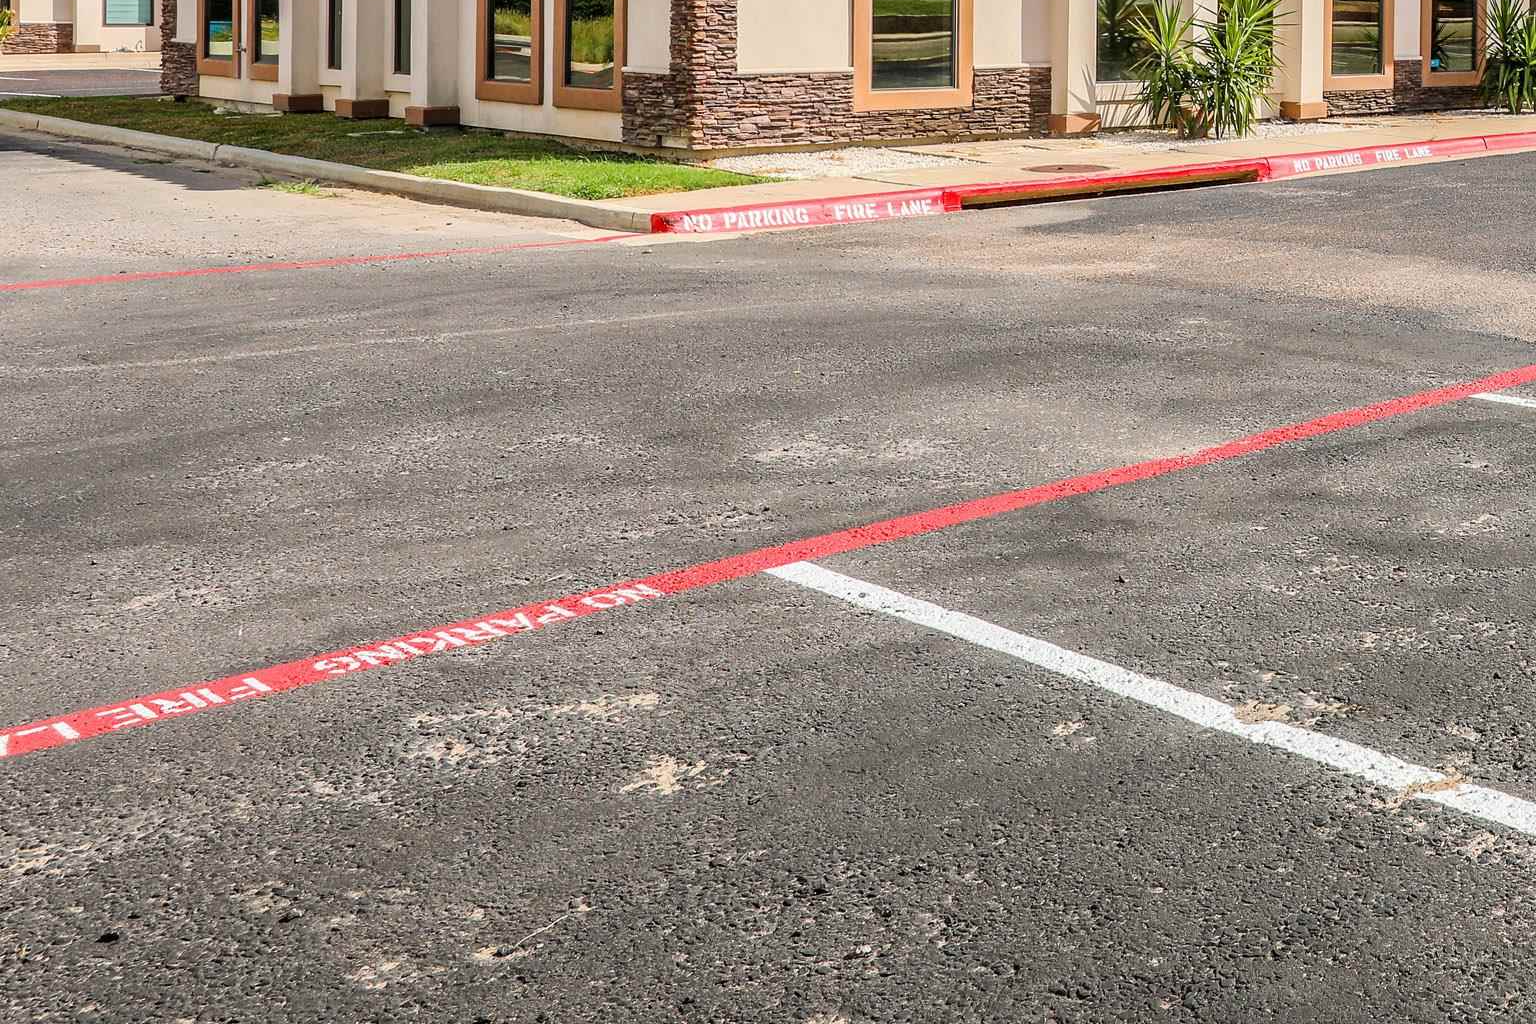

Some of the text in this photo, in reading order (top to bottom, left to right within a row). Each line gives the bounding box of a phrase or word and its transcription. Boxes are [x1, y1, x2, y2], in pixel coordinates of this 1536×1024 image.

[1293, 145, 1432, 173] NO PARKING FIRE LANE
[683, 199, 937, 232] NO PARKING FIRE LANE
[584, 583, 664, 608] NO
[313, 606, 577, 675] PARKING
[96, 677, 272, 729] FIRE
